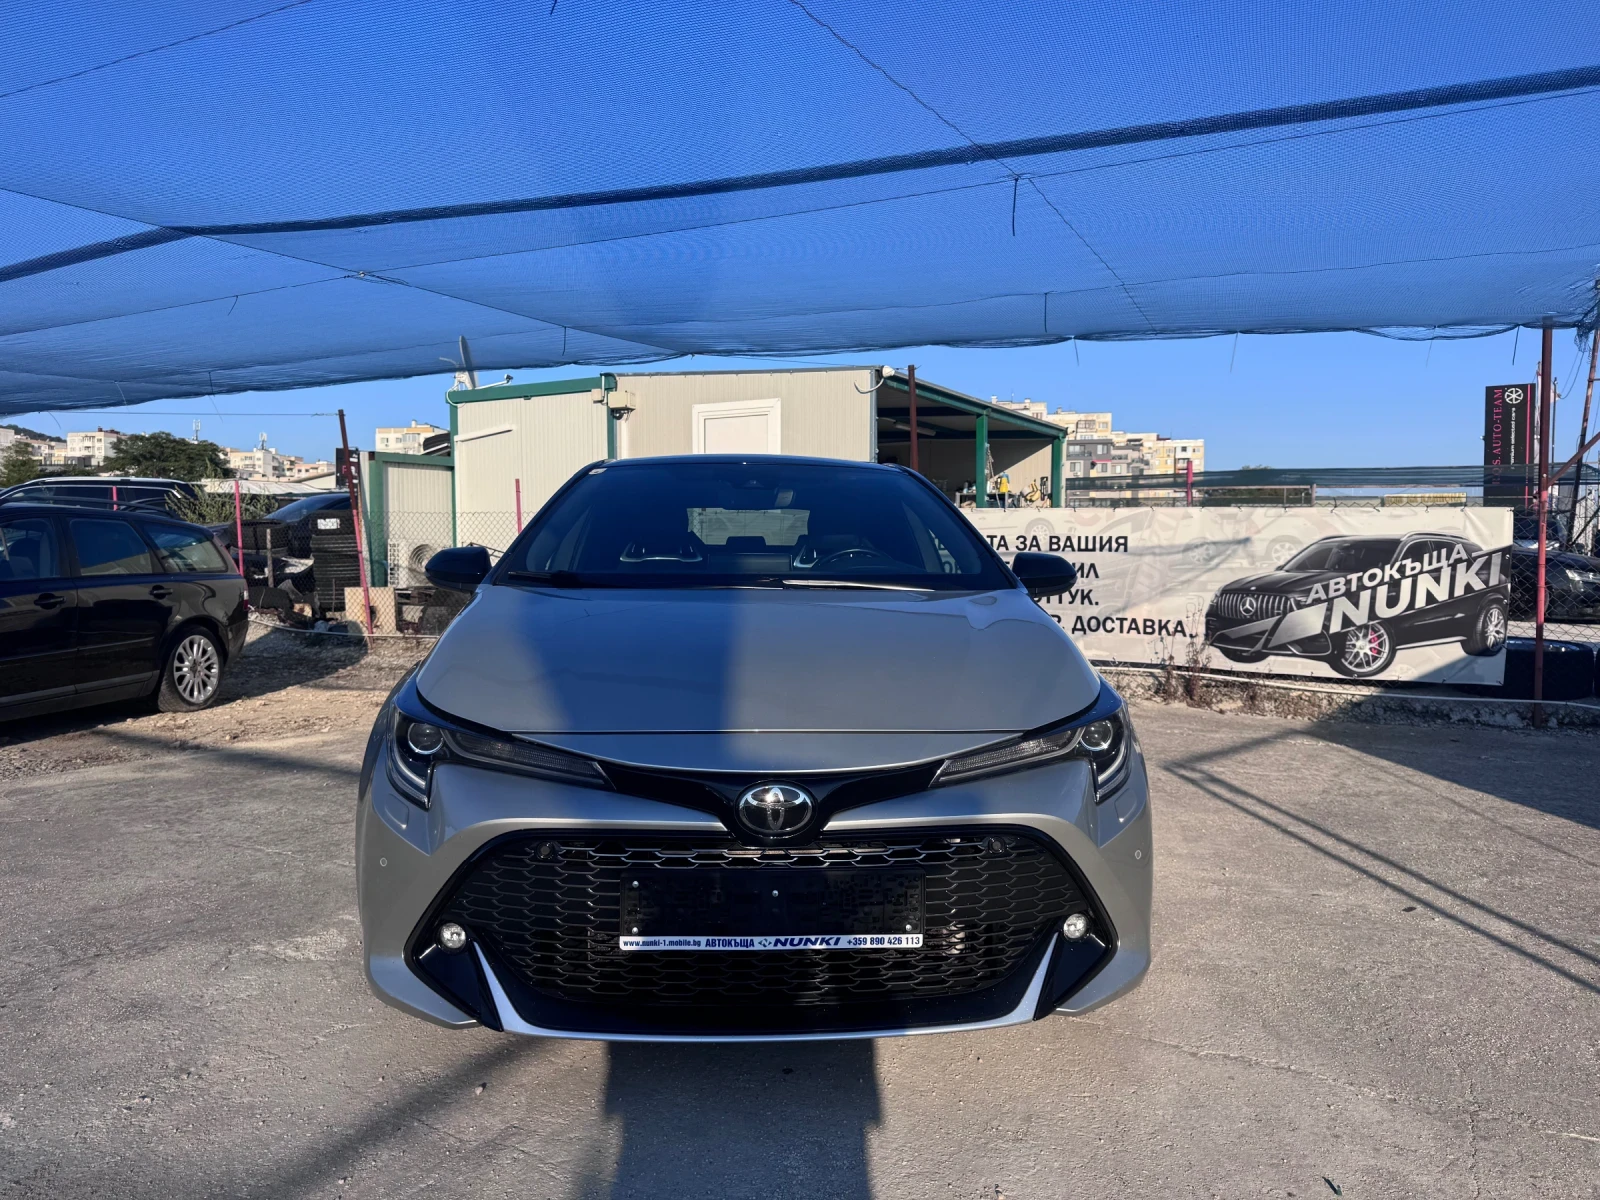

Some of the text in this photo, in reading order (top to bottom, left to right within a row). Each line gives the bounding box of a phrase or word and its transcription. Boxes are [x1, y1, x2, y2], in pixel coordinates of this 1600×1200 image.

[1015, 535, 1042, 551] ЗА
[1049, 535, 1129, 552] ВАШИЯ
[1306, 543, 1469, 604] АВТОКЪЩА
[1329, 551, 1502, 634] NUNKI
[622, 936, 920, 949] www.nunki-1.mobile.bg АВТОКЪЩА NUNKI +359 890 426 113
